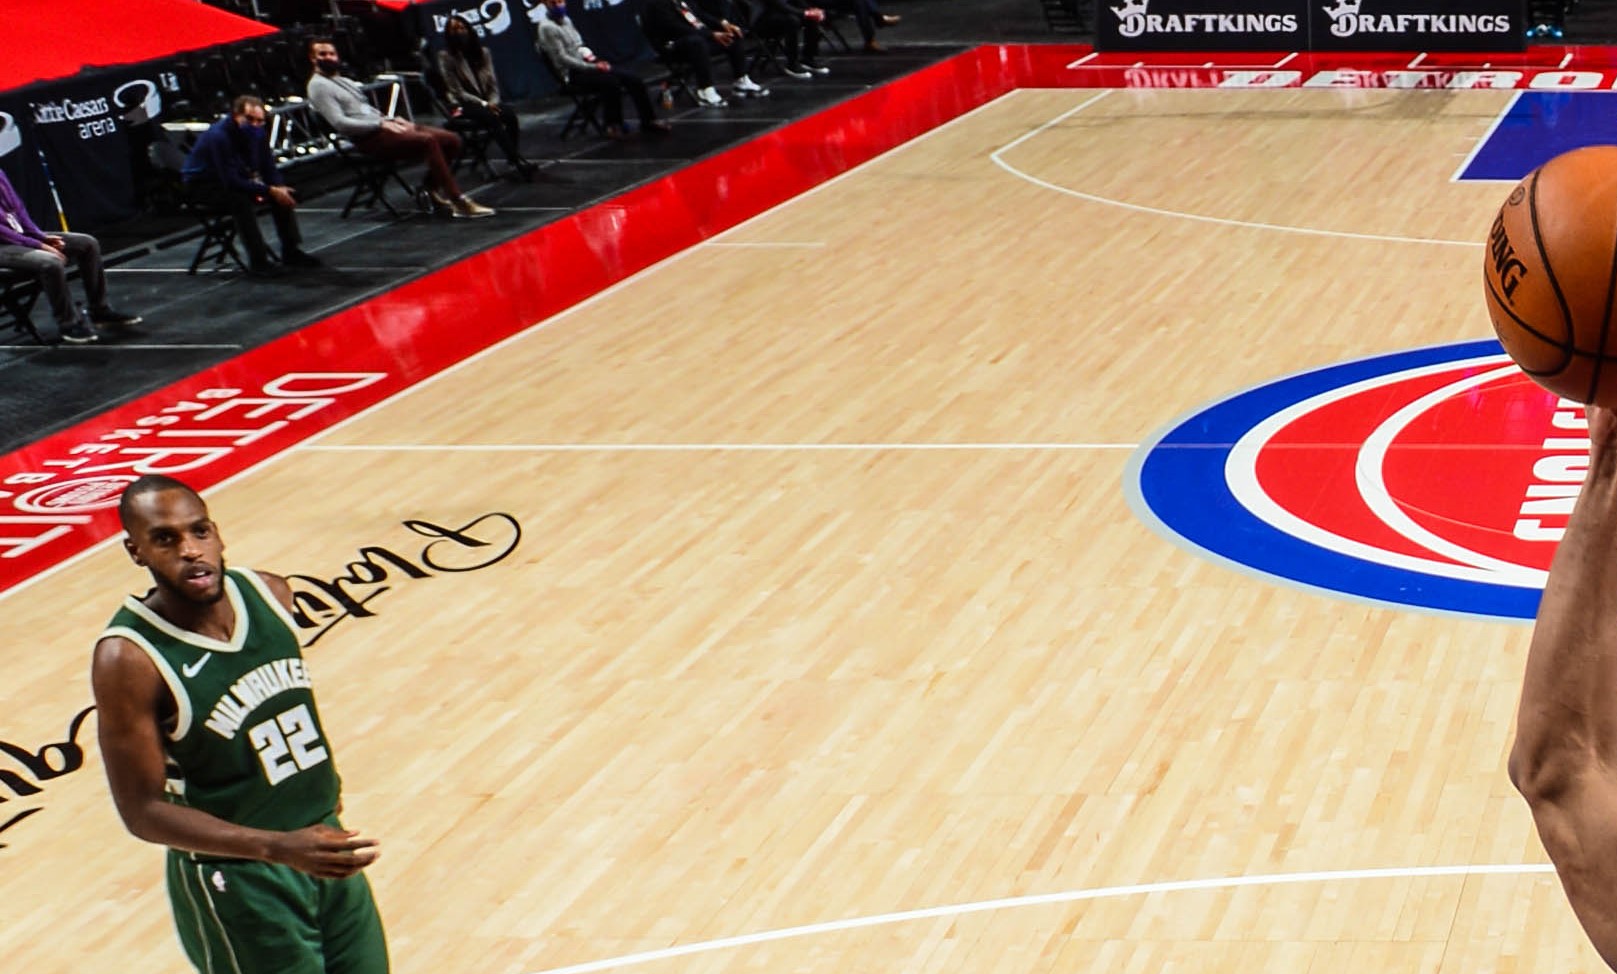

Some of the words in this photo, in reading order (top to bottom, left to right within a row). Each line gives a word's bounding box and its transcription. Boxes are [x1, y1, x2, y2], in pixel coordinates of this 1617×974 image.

[1118, 13, 1298, 38] DRAFTKINGS
[1330, 13, 1511, 38] DRAFTKINGS
[77, 116, 117, 140] arena
[248, 703, 329, 787] 22
